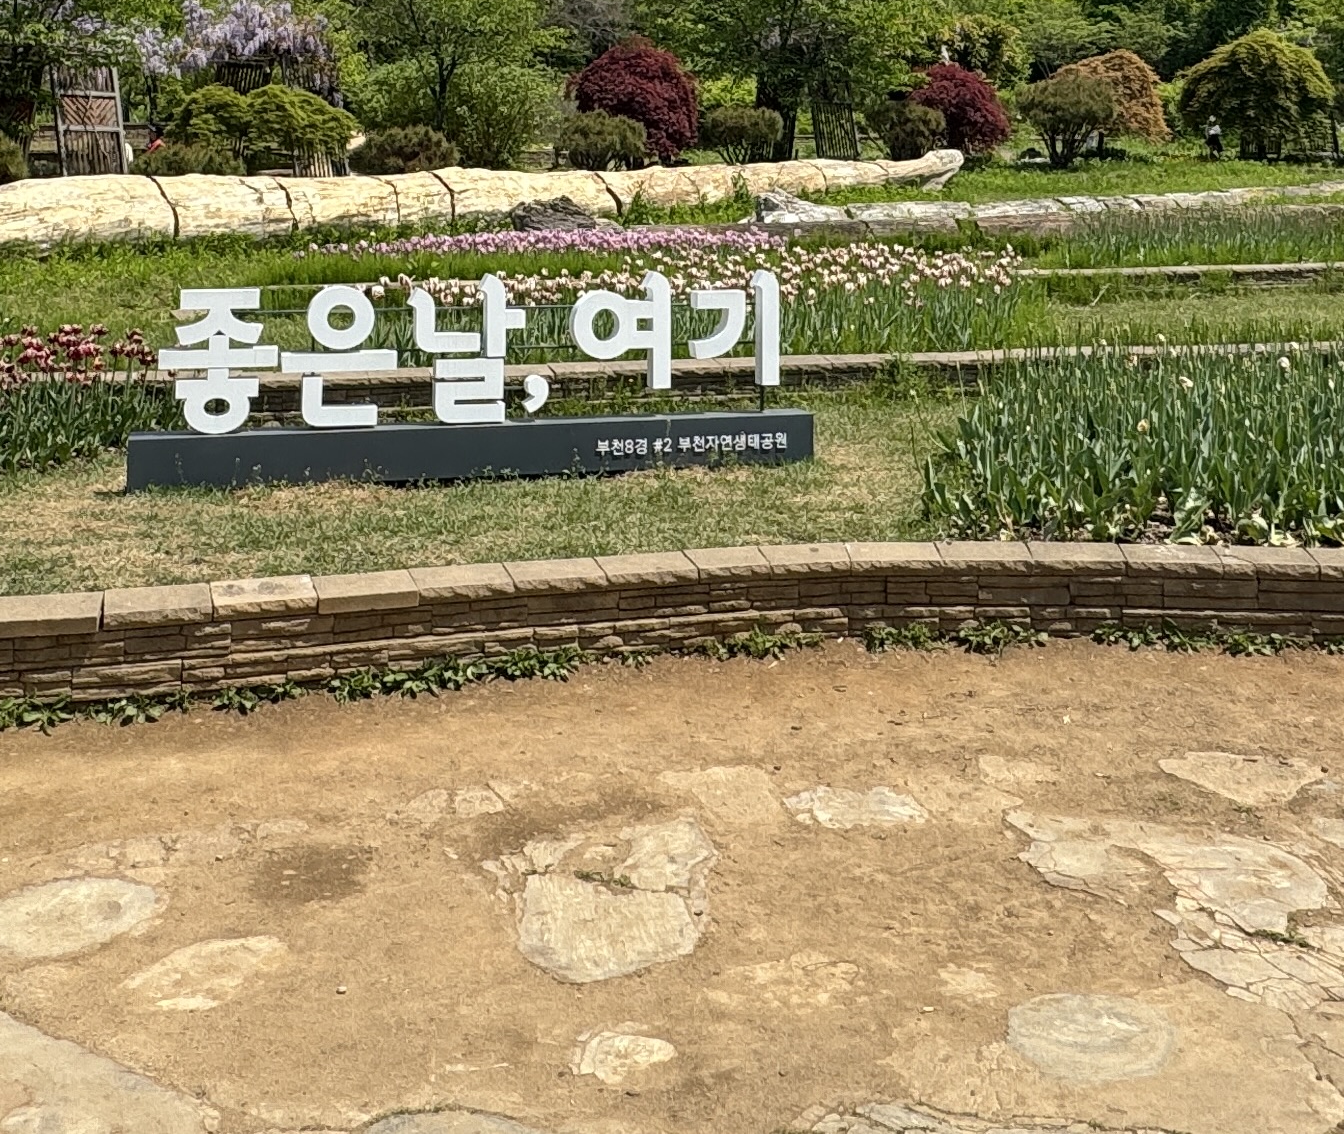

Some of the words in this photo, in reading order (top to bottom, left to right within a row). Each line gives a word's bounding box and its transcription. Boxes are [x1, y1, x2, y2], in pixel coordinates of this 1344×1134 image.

[570, 269, 780, 389] 여기
[595, 438, 648, 455] 부천8경
[652, 437, 673, 453] #2
[677, 431, 788, 452] 부천자연생태공원
